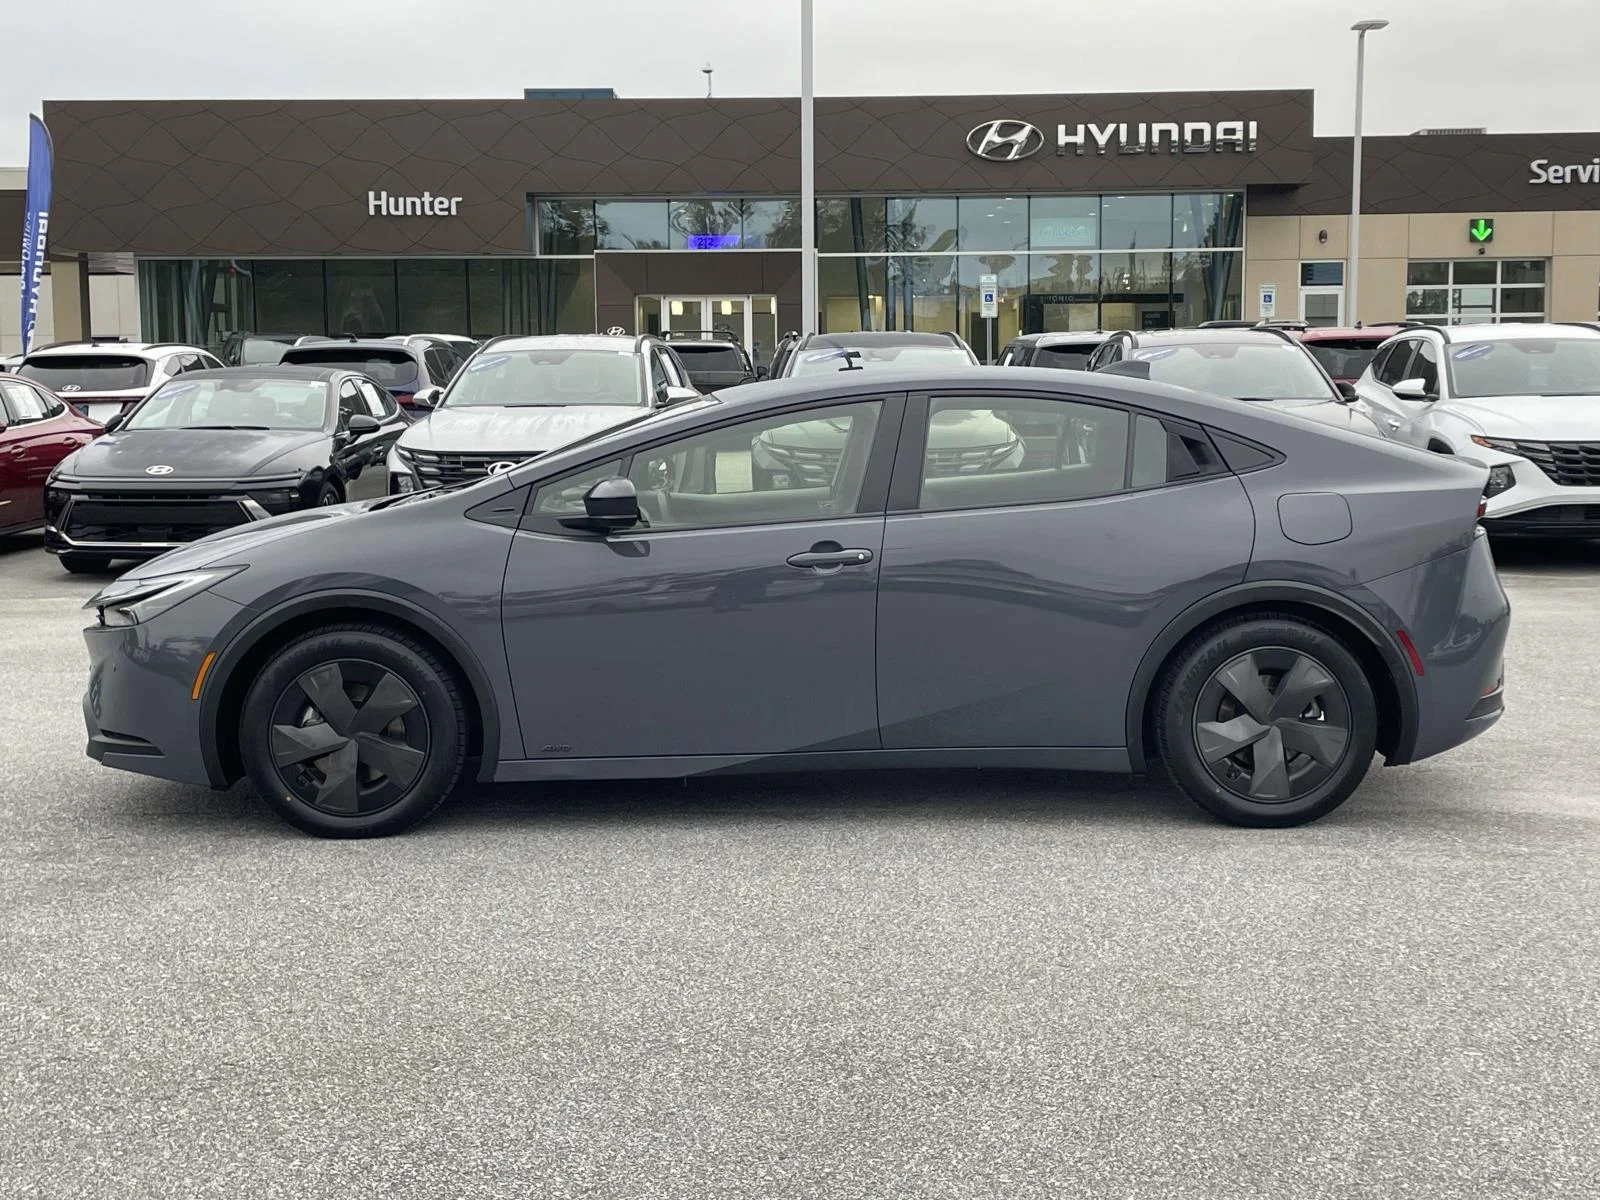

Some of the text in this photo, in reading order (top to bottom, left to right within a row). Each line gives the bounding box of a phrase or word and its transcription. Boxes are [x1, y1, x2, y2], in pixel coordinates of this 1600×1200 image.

[1057, 121, 1258, 156] HYUNDAI
[1528, 158, 1600, 184] Servi
[368, 191, 463, 216] Hunter
